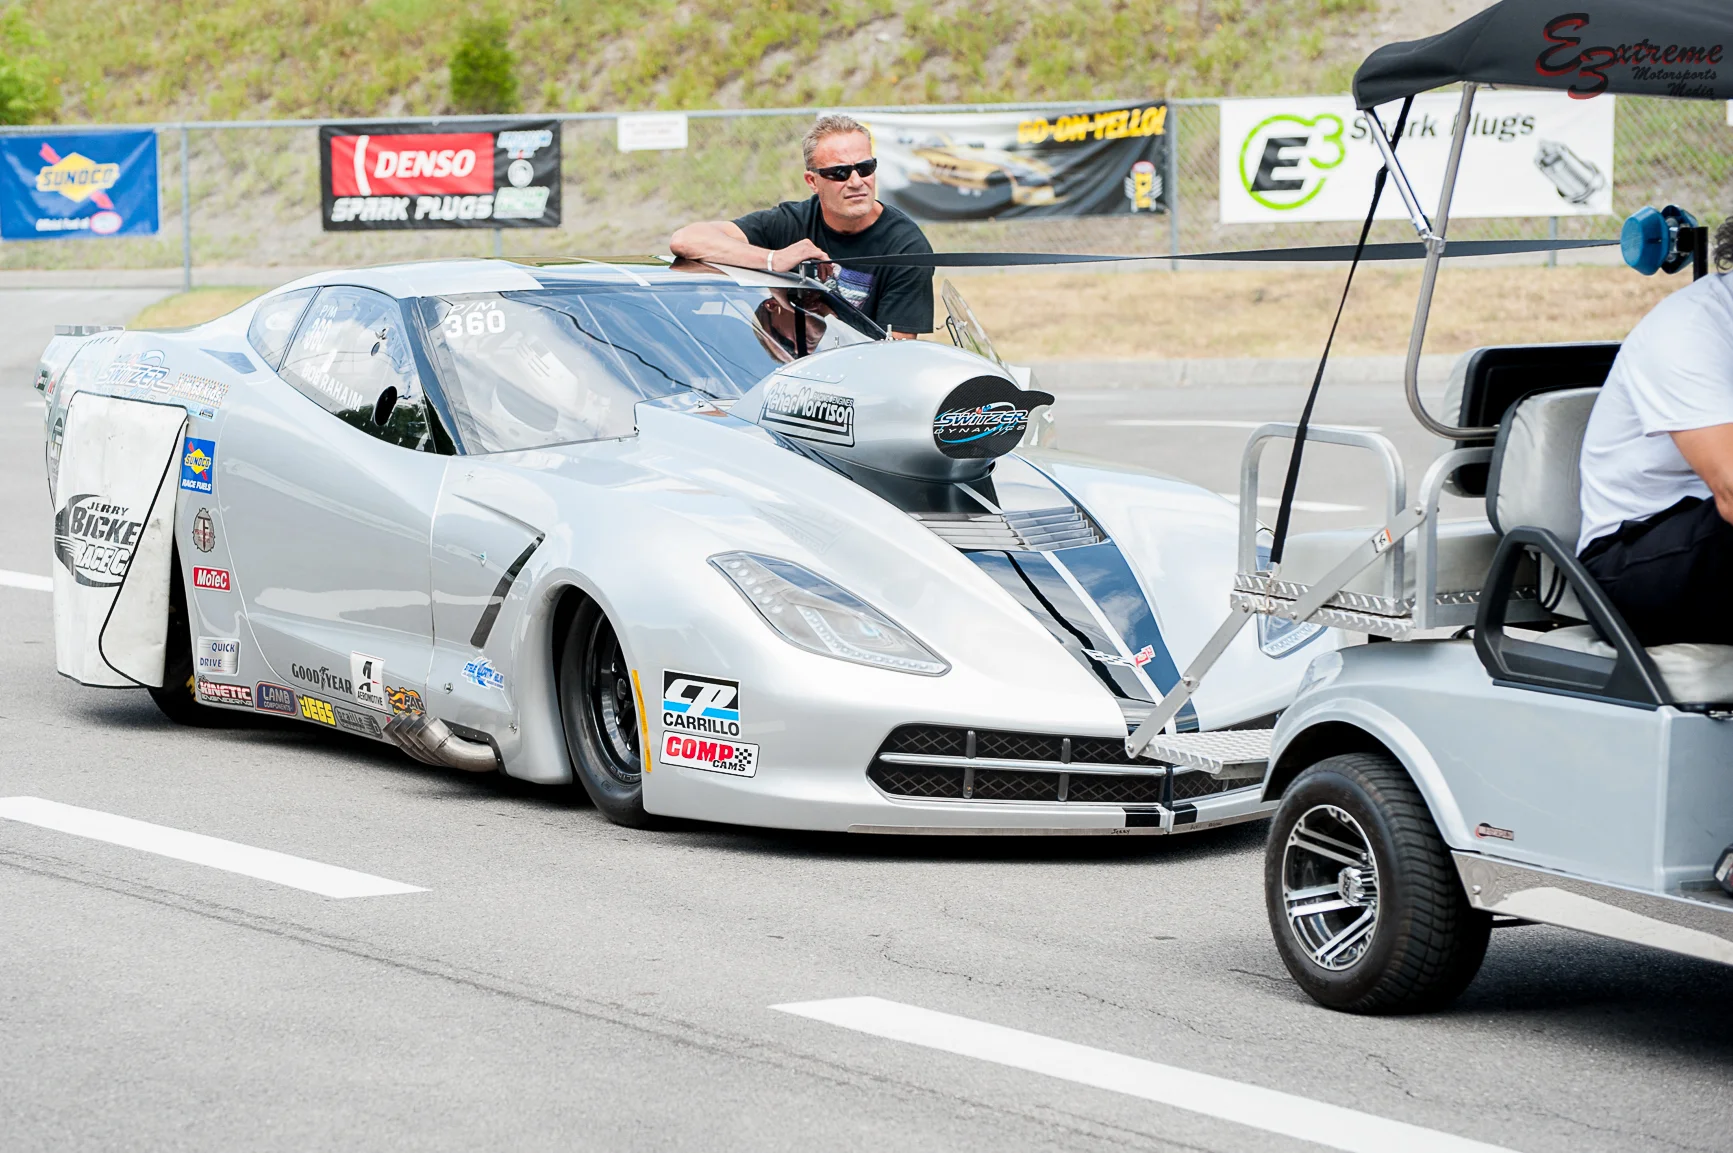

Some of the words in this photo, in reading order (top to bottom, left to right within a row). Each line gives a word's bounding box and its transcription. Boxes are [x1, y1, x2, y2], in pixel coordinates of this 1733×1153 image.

[374, 149, 476, 179] DENSO
[43, 167, 114, 187] SUNOCO
[331, 196, 410, 222] SPARK
[414, 195, 495, 221] PLUGS
[444, 309, 506, 338] 360
[934, 410, 1028, 427] SWITZER
[934, 424, 1026, 435] DYNAMICS
[184, 455, 210, 468] SUNOCO
[181, 478, 196, 489] RACE
[196, 481, 212, 492] FUELS
[87, 502, 129, 516] JERRY
[197, 569, 227, 588] MoTeC
[212, 642, 235, 653] QUICK
[200, 657, 222, 668] DRIVE
[200, 682, 252, 701] KINETIC
[262, 686, 291, 705] LAMB
[665, 679, 737, 716] CP
[299, 696, 336, 726] JEGS
[663, 712, 740, 736] CARRILLO
[666, 736, 734, 763] COMP
[712, 760, 747, 772] CAMS
